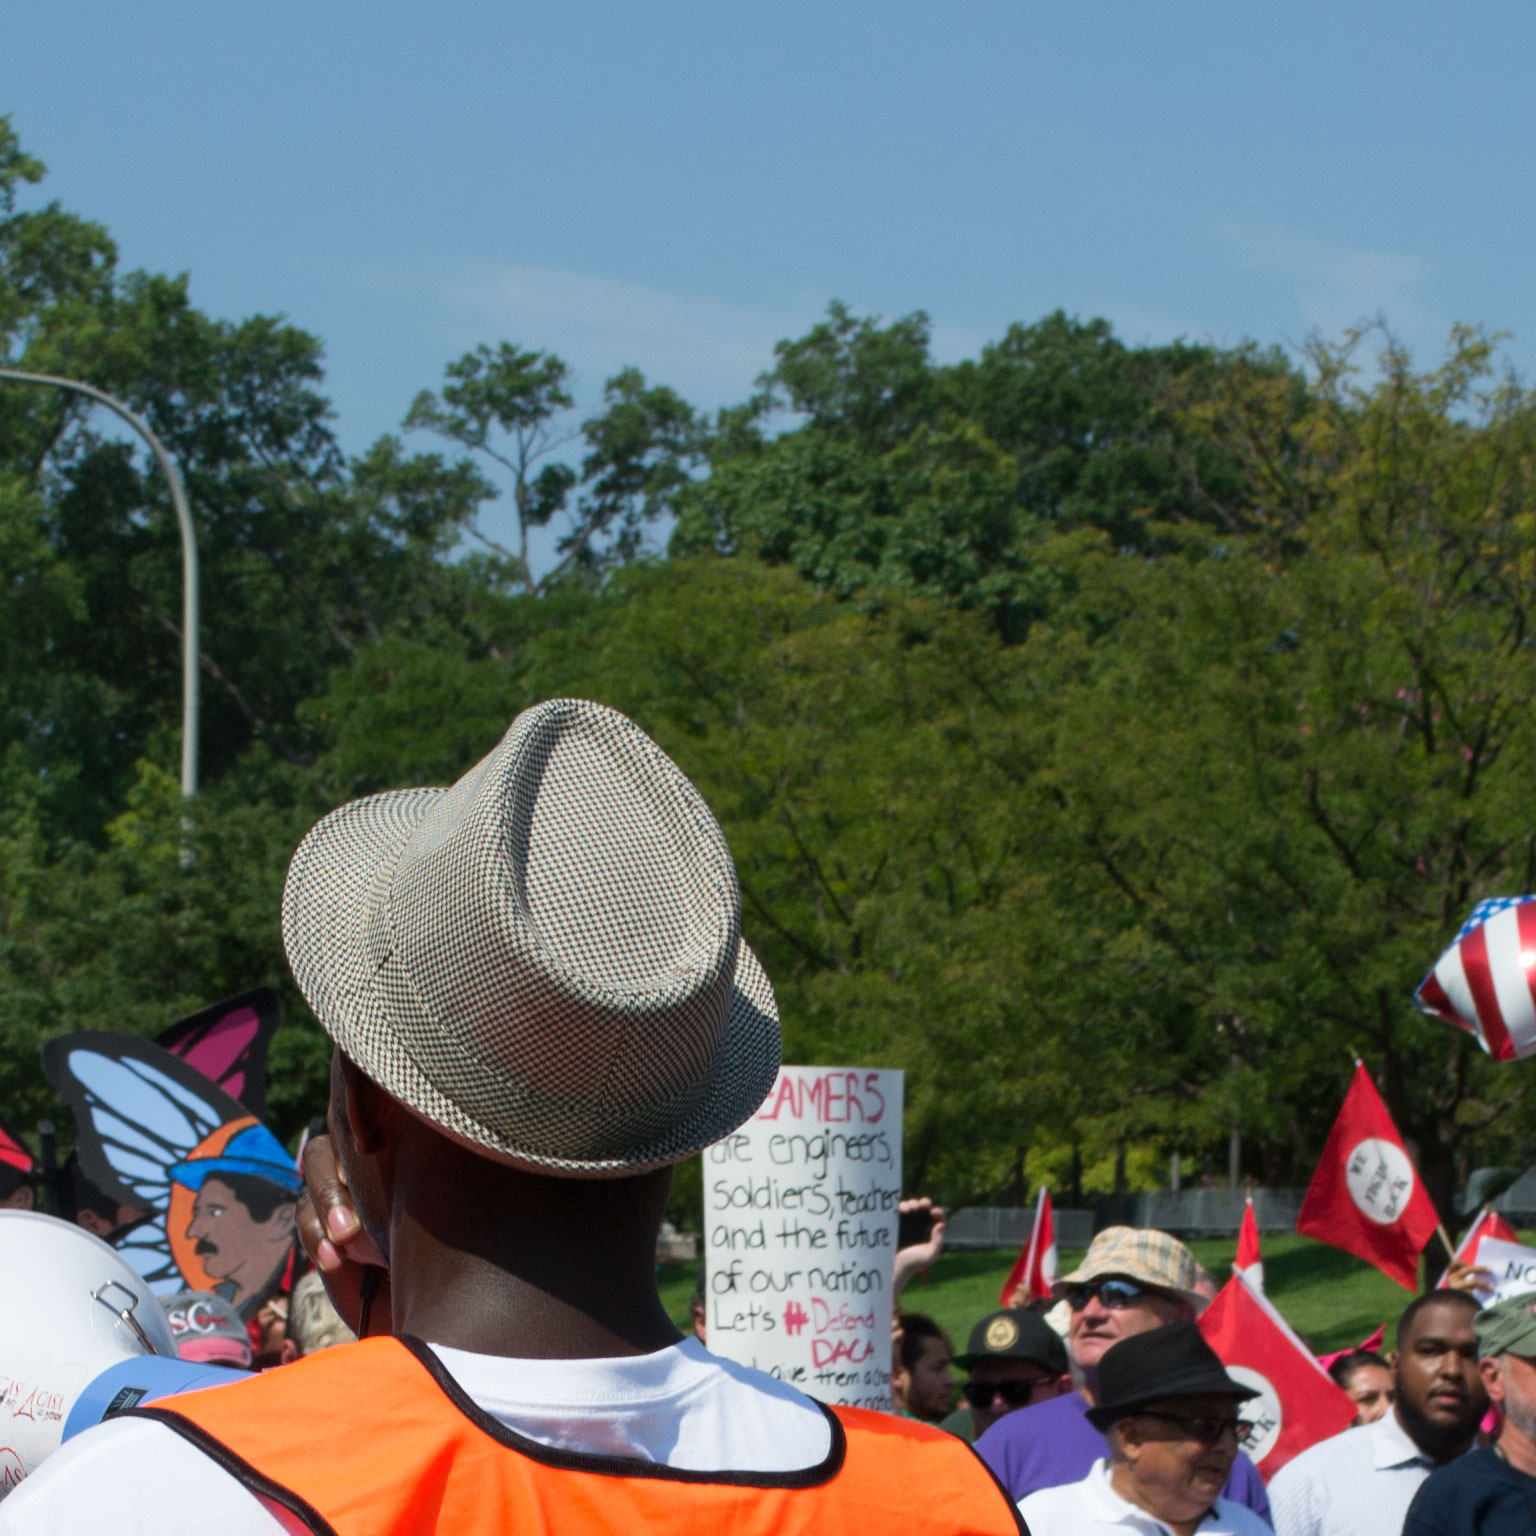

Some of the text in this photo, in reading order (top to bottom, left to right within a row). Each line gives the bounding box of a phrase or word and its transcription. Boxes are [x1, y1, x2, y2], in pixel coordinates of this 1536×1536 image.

[712, 1219, 890, 1251] and the future
[712, 1260, 882, 1294] of our nation
[811, 1338, 875, 1369] DACA
